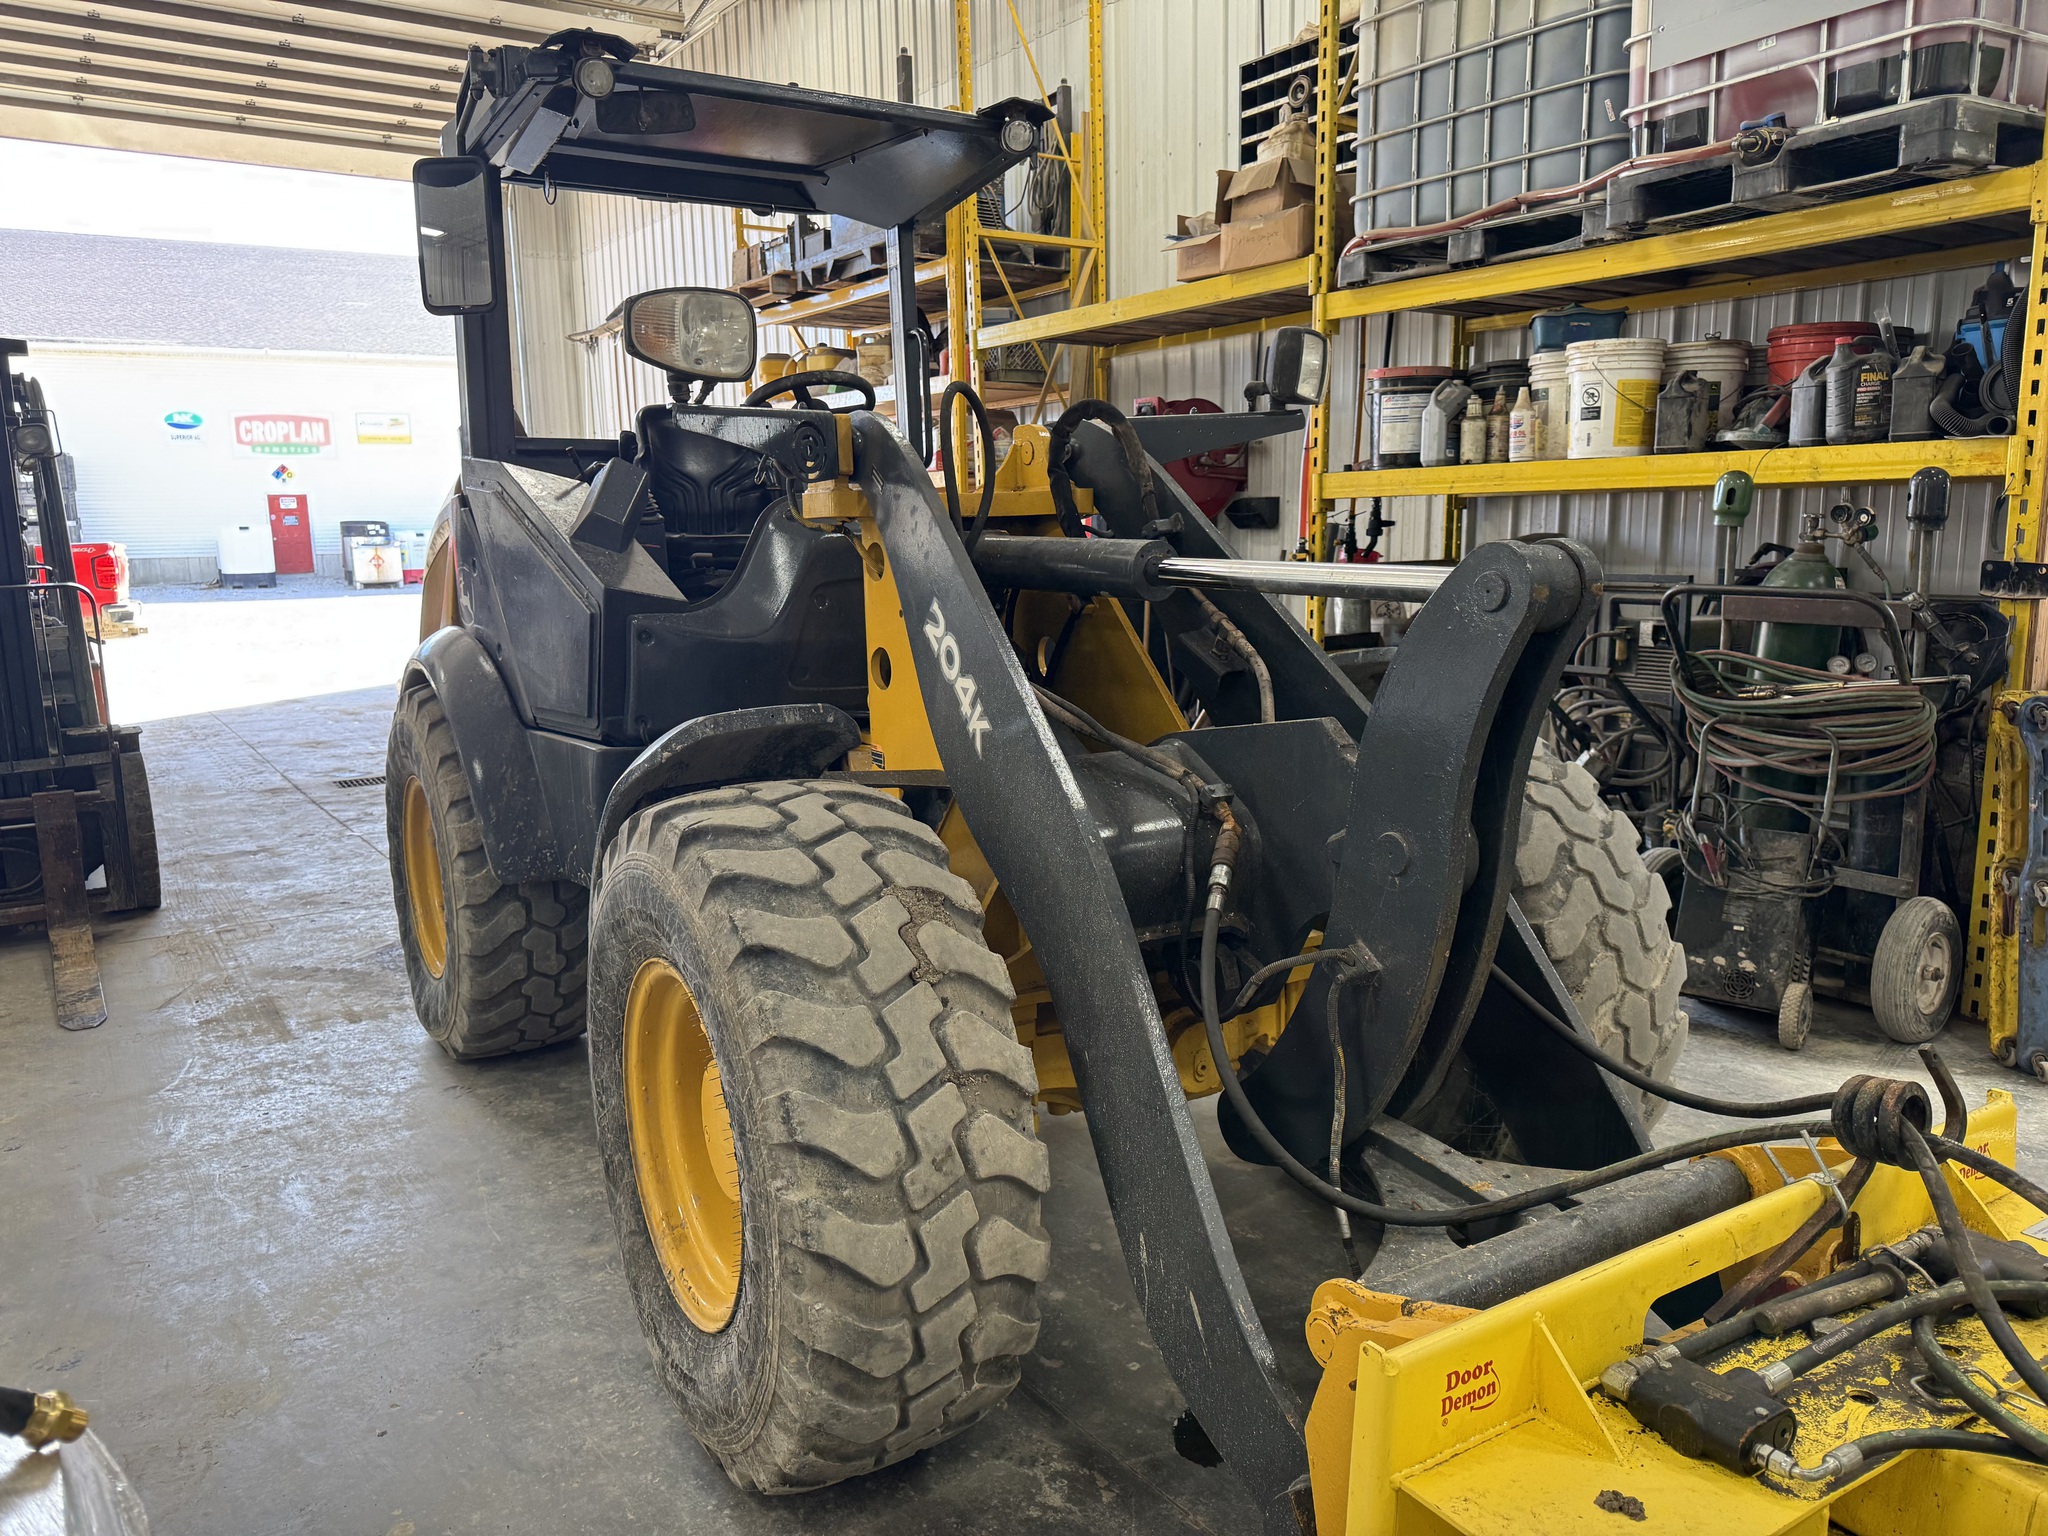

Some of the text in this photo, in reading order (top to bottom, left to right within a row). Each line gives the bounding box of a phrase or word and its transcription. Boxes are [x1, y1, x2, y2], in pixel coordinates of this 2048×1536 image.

[1860, 371, 1889, 382] FINAL
[239, 420, 326, 443] CROPLAN
[923, 597, 992, 760] 204K
[1446, 1360, 1494, 1393] Door
[1441, 1380, 1497, 1418] Demon
